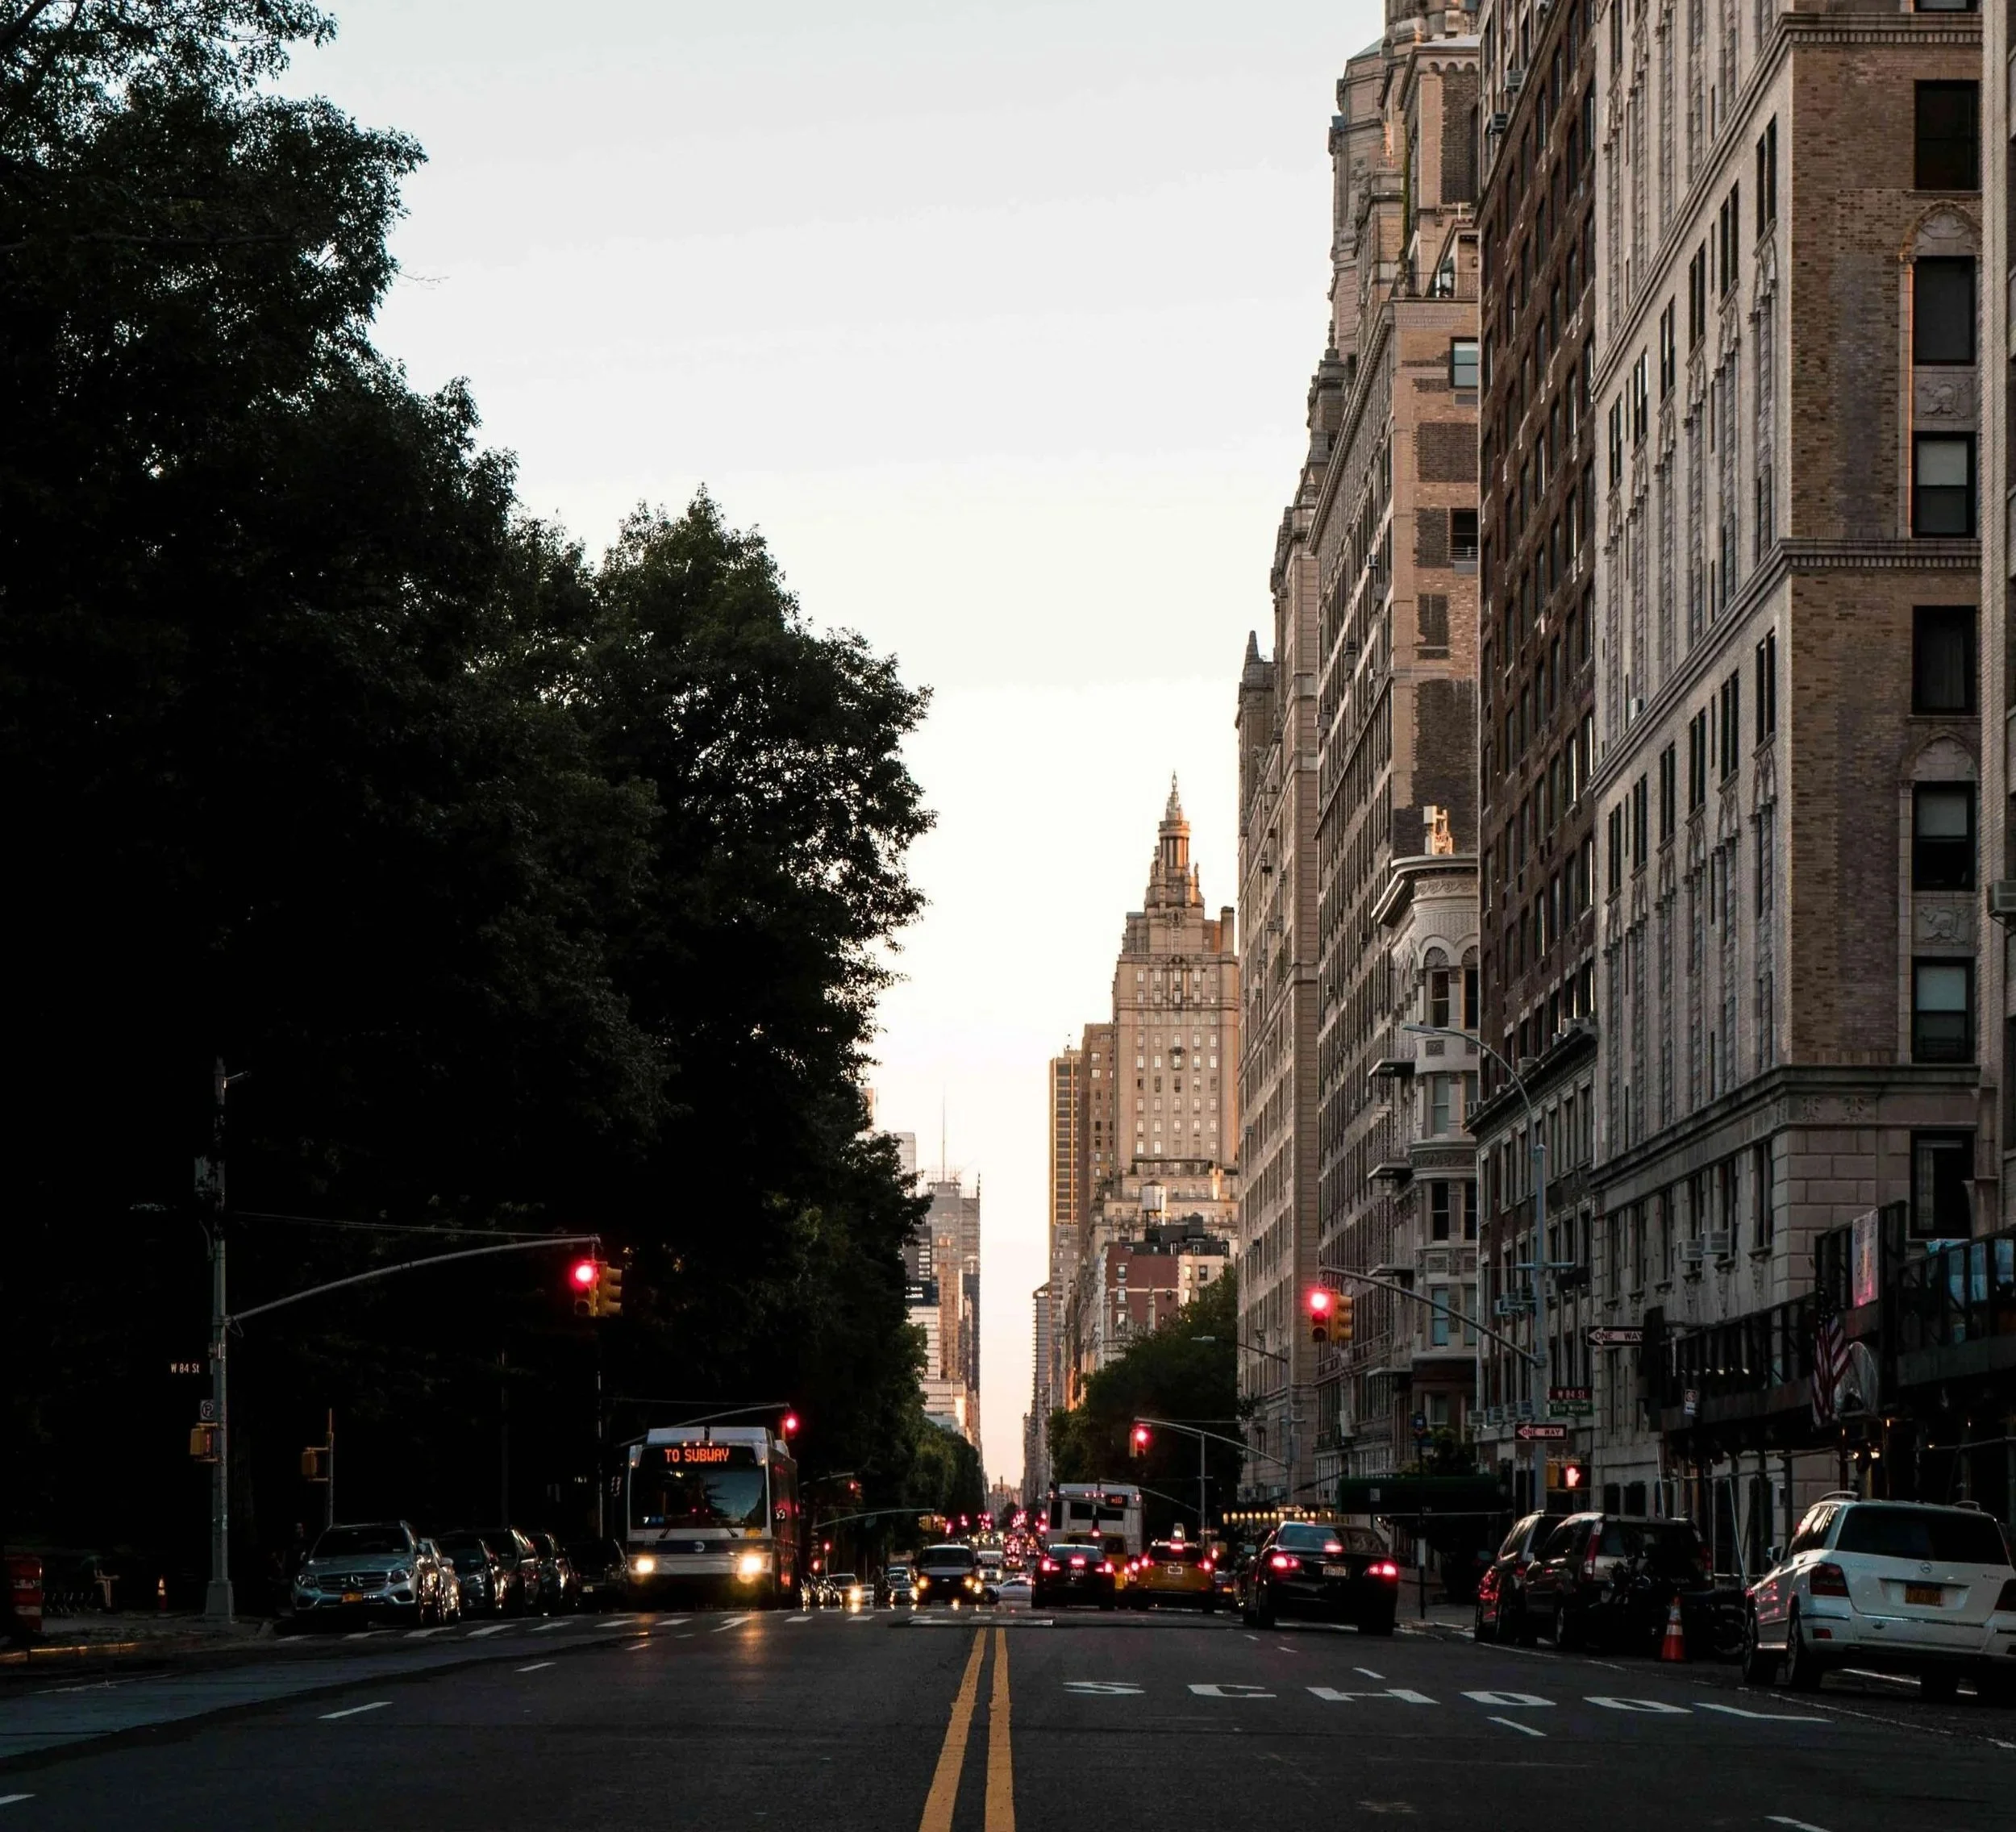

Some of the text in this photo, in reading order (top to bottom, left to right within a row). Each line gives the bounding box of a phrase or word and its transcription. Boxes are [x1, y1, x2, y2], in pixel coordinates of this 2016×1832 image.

[1595, 1330, 1614, 1340] ONE
[170, 1362, 177, 1374] W
[179, 1362, 190, 1374] 84
[664, 1447, 729, 1463] TO SUBWAY
[1063, 1681, 1832, 1722] SCHOOL
